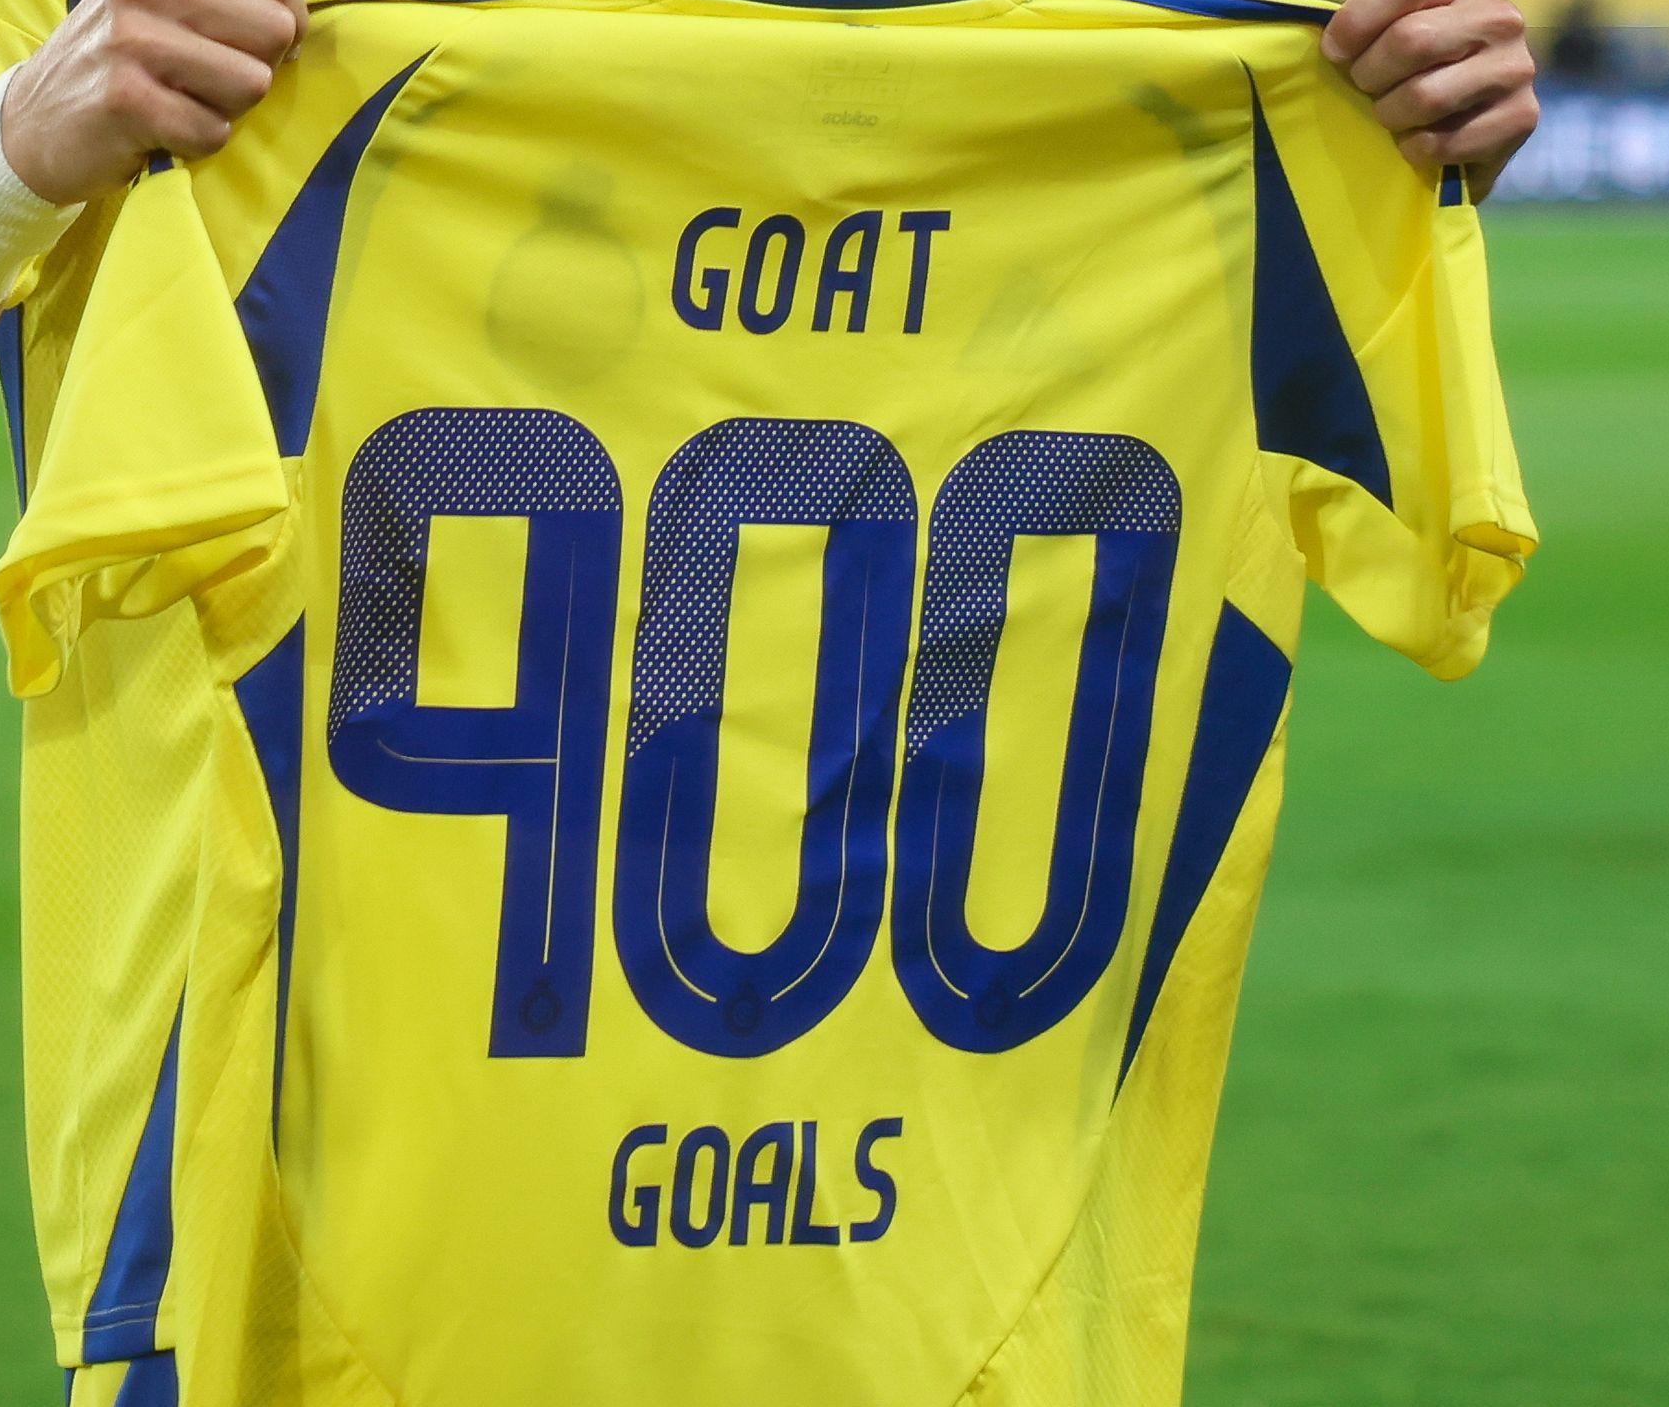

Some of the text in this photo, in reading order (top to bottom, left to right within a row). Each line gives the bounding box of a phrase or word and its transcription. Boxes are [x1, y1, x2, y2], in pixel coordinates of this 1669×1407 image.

[671, 206, 950, 335] GOAT
[327, 406, 1182, 1059] 900
[607, 1116, 903, 1249] GOALS
